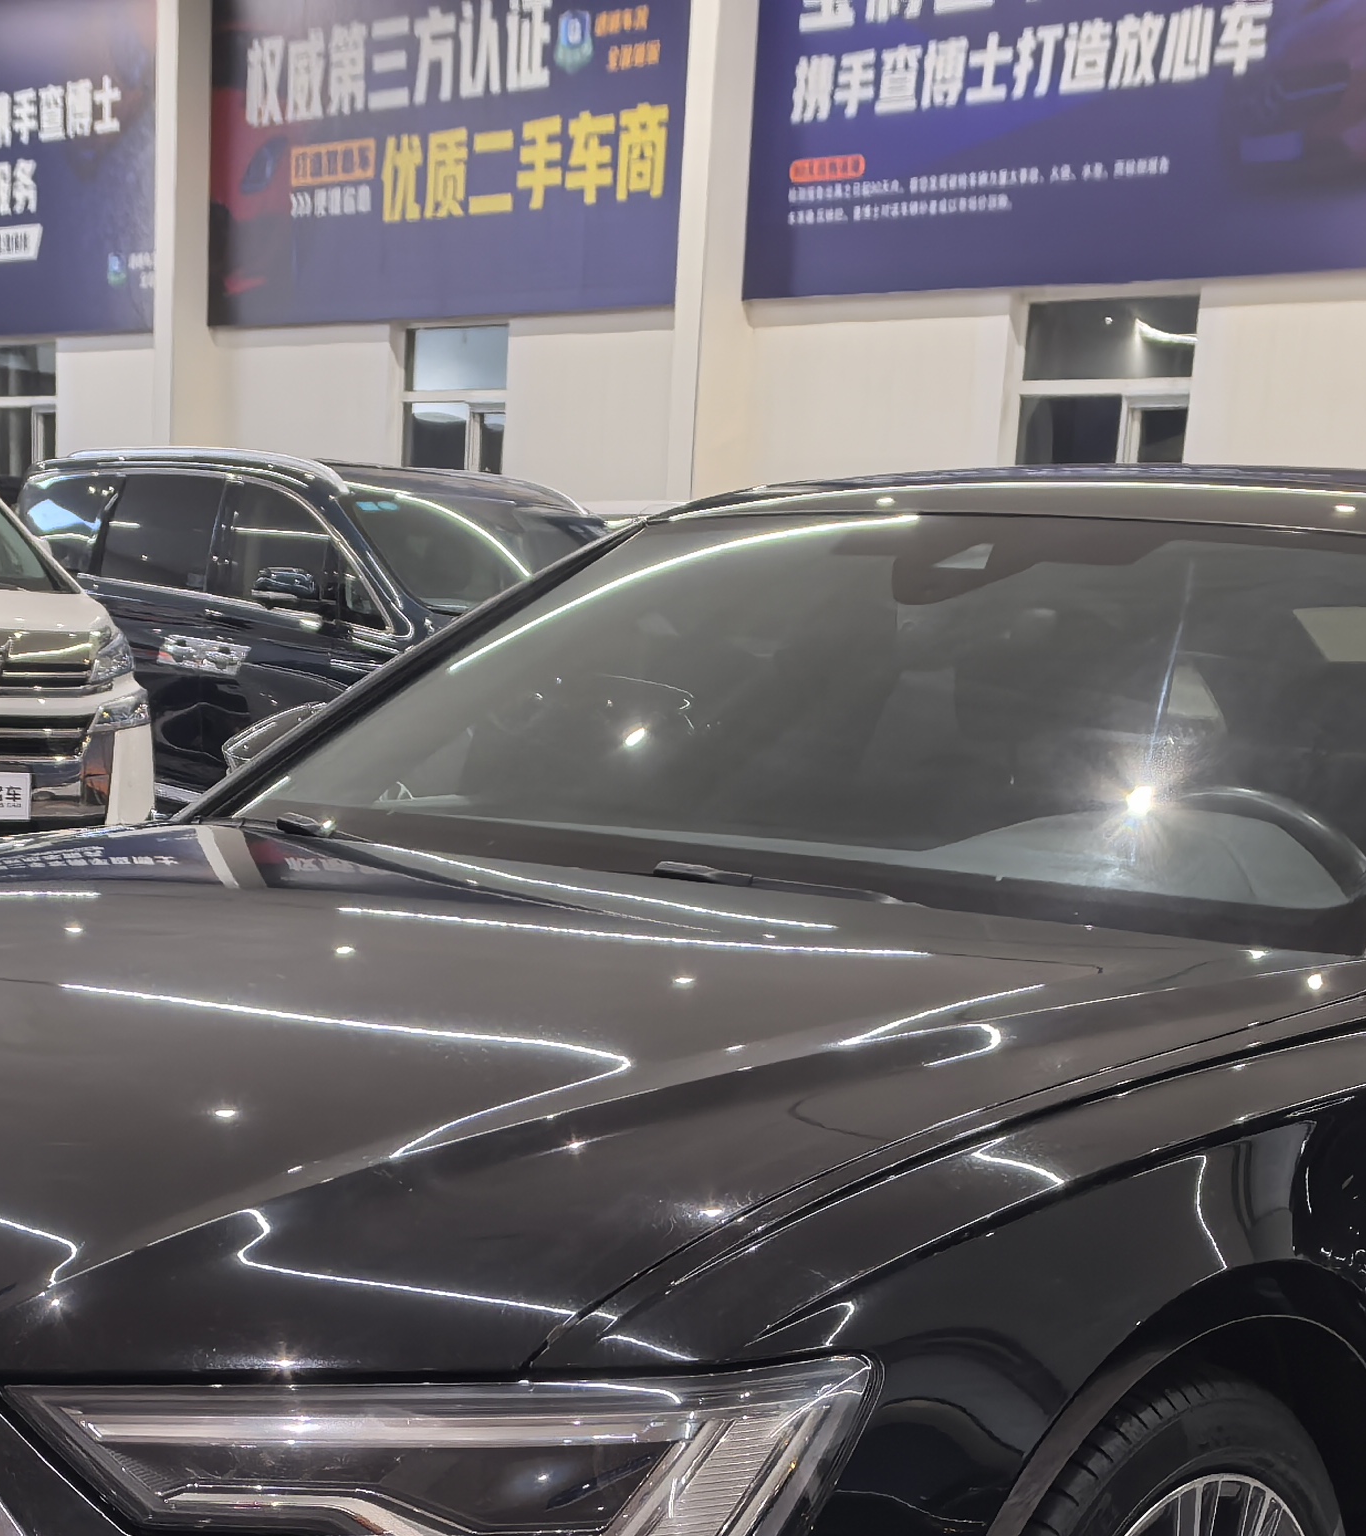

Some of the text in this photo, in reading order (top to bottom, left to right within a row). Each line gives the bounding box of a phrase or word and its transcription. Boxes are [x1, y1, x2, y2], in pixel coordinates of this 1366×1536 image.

[245, 0, 552, 127] 权威第三方认证
[790, 0, 1274, 125] 携手查博士打造放心车
[381, 103, 670, 223] 优质二手车商
